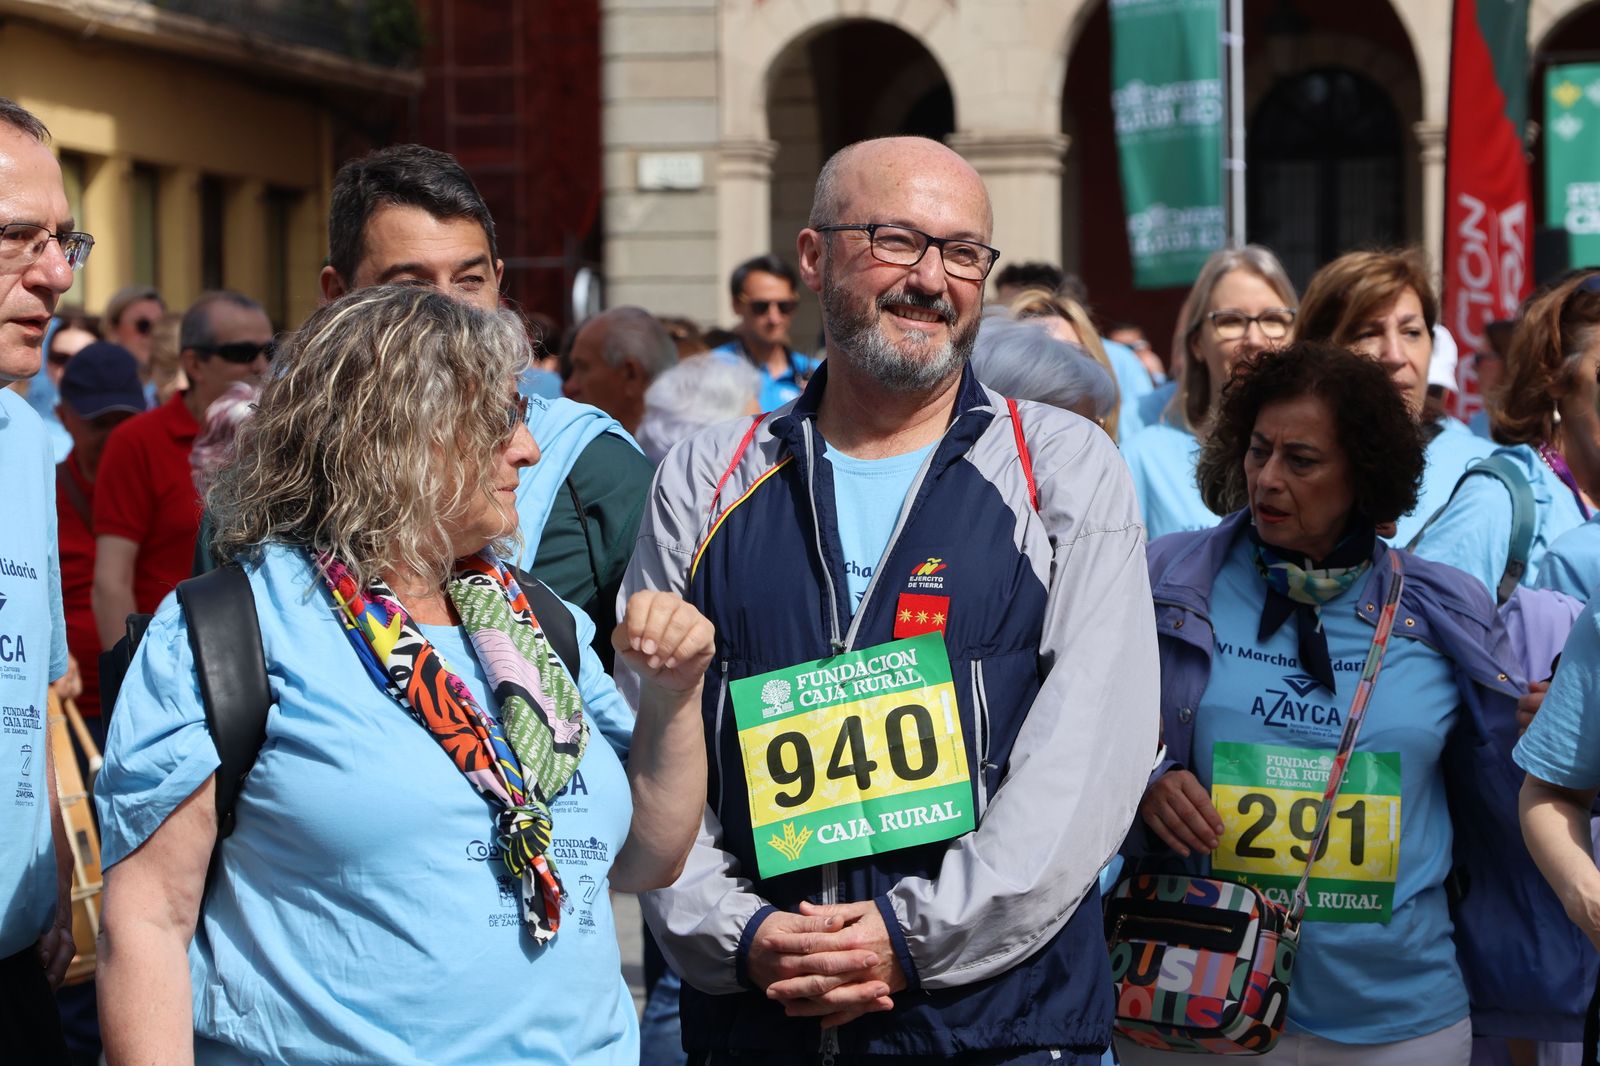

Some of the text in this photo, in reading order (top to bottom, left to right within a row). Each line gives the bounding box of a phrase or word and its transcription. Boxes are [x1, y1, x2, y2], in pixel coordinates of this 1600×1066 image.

[844, 560, 872, 578] cha
[1217, 642, 1232, 655] VI
[1238, 646, 1297, 668] Marcha
[795, 648, 918, 690] FUNDACION
[800, 668, 922, 707] CAJA RURAL
[1251, 688, 1342, 728] AZAYCA
[3, 716, 21, 728] CAJA
[766, 704, 939, 808] 940
[1266, 766, 1298, 779] CAJA
[1280, 780, 1312, 788] ZAMORA
[817, 801, 962, 845] CAJA RURAL
[1235, 793, 1366, 866] 291
[554, 848, 609, 862] CAJA RURAL
[1317, 891, 1382, 910] RURAL
[489, 919, 526, 927] DE ZAMO
